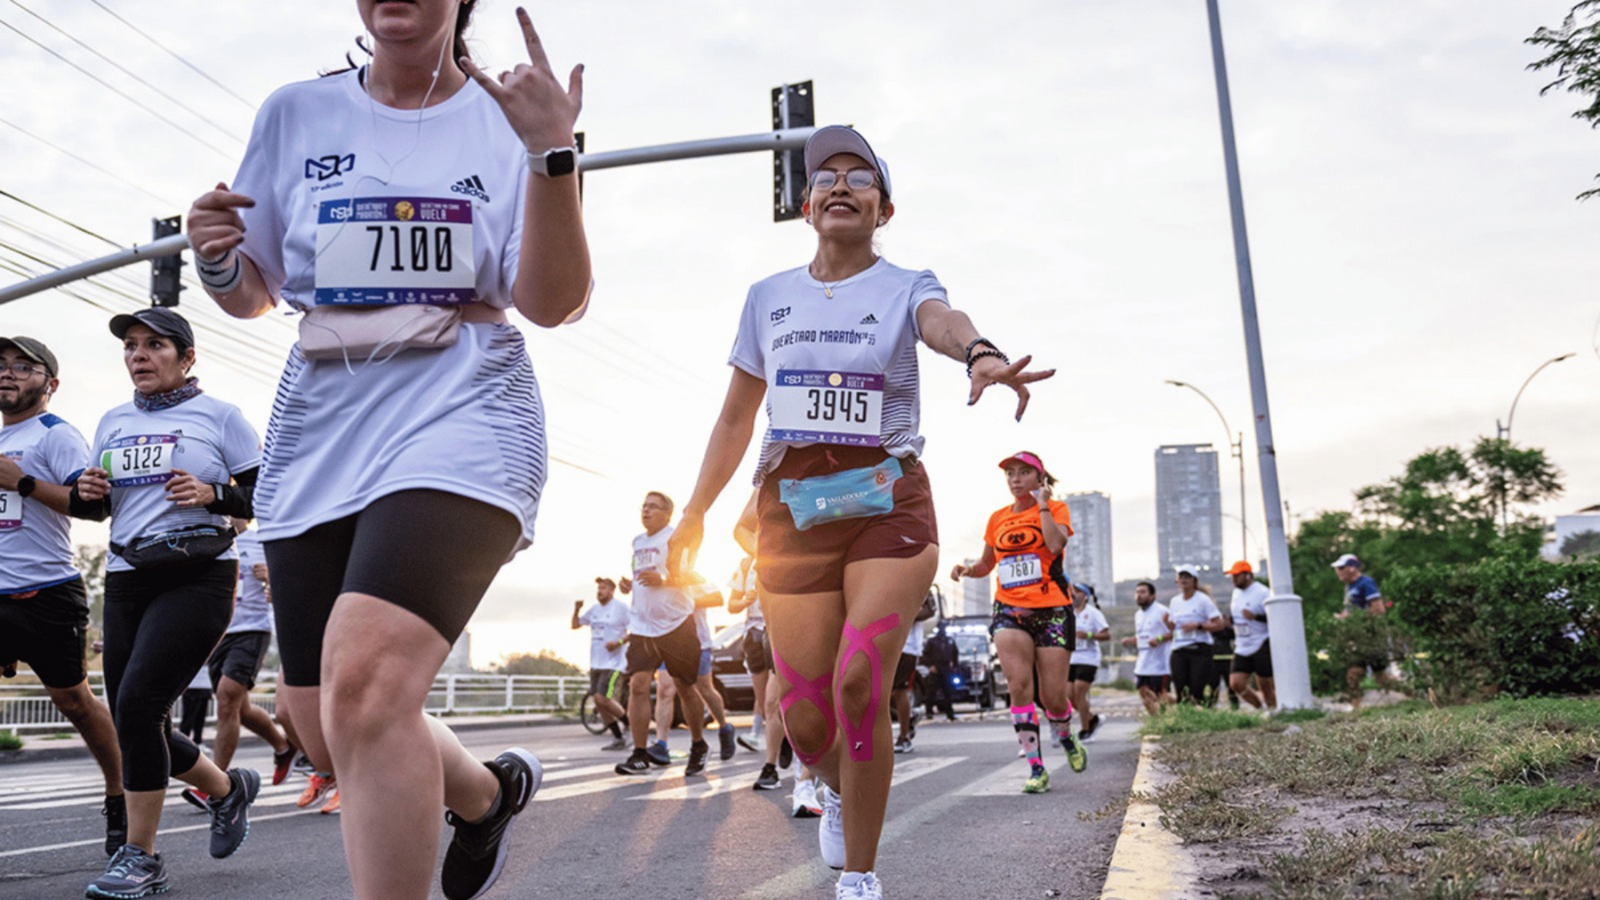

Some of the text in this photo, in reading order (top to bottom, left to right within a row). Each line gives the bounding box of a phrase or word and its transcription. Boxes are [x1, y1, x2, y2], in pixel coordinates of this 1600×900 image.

[450, 184, 490, 203] adidas
[366, 226, 452, 272] 7100
[819, 329, 861, 344] MARATÓN
[807, 389, 868, 423] 3945
[122, 445, 162, 471] 5122
